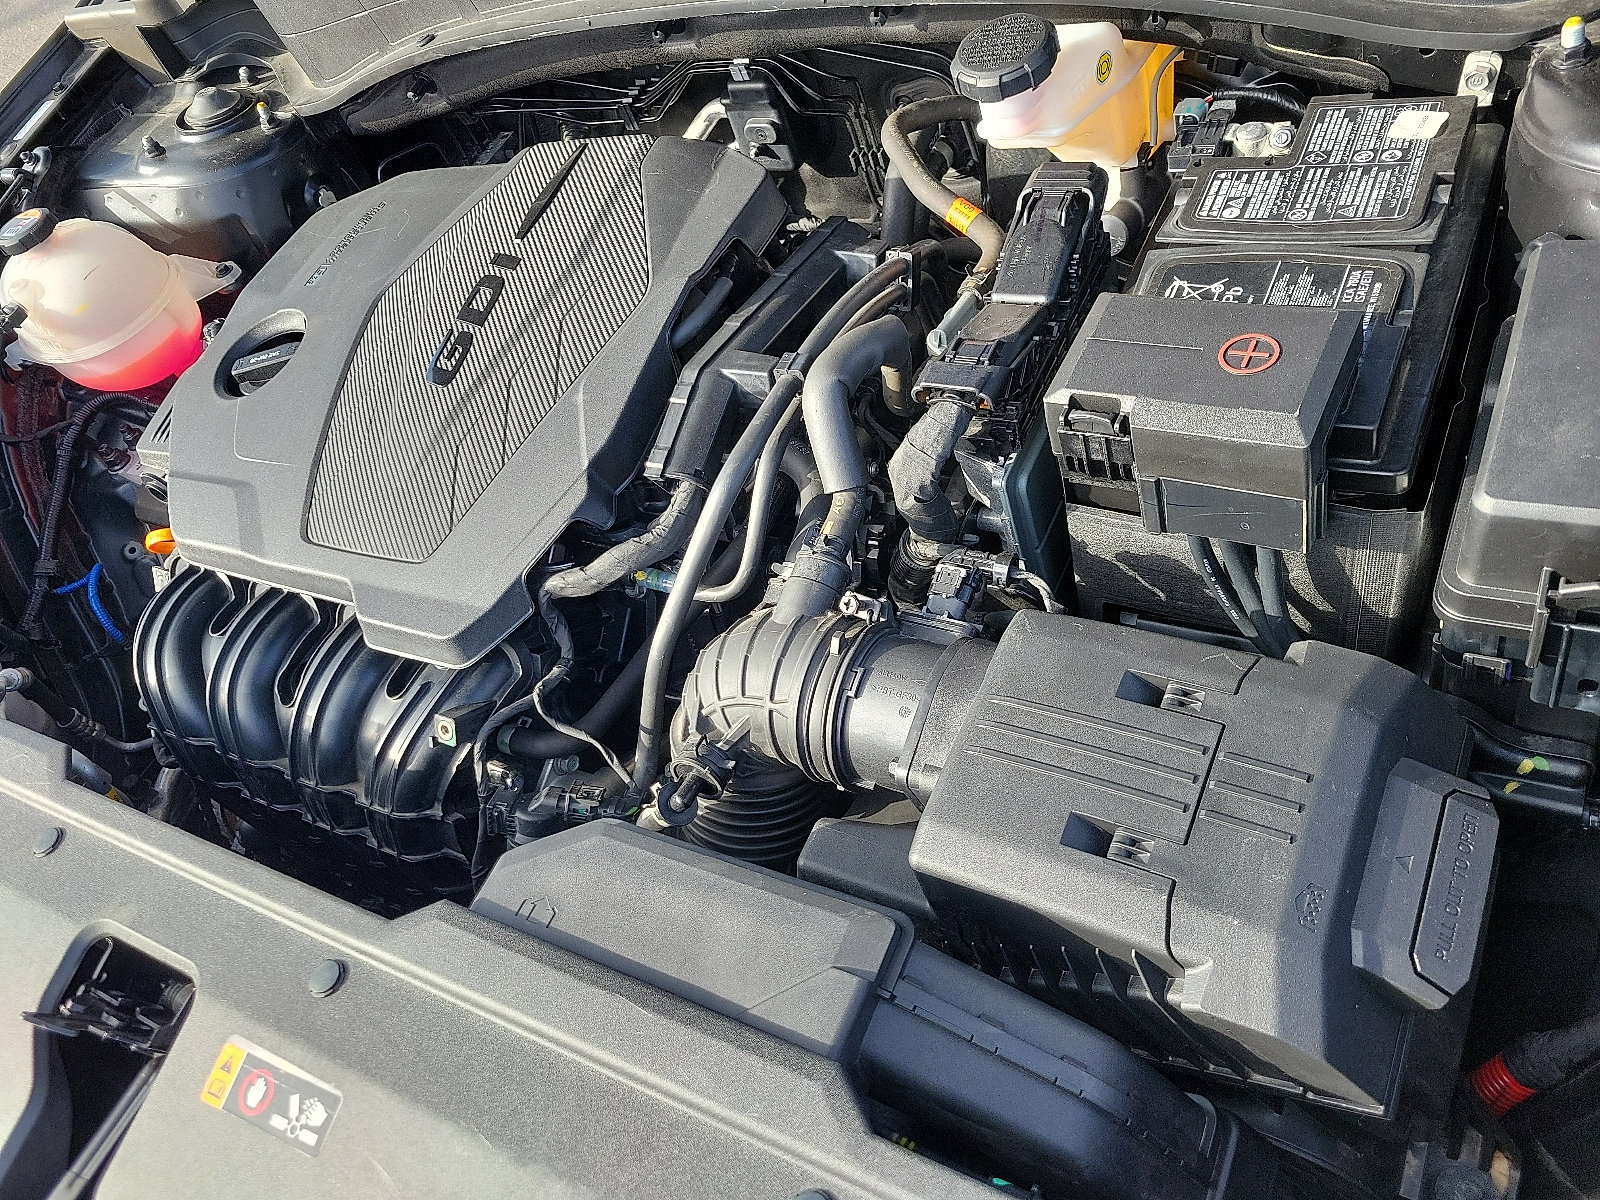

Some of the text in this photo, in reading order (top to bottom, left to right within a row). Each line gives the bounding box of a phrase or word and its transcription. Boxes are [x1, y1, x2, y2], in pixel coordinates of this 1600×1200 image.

[1222, 287, 1243, 303] Pb
[1435, 812, 1480, 962] PULL OUT TO OPEN
